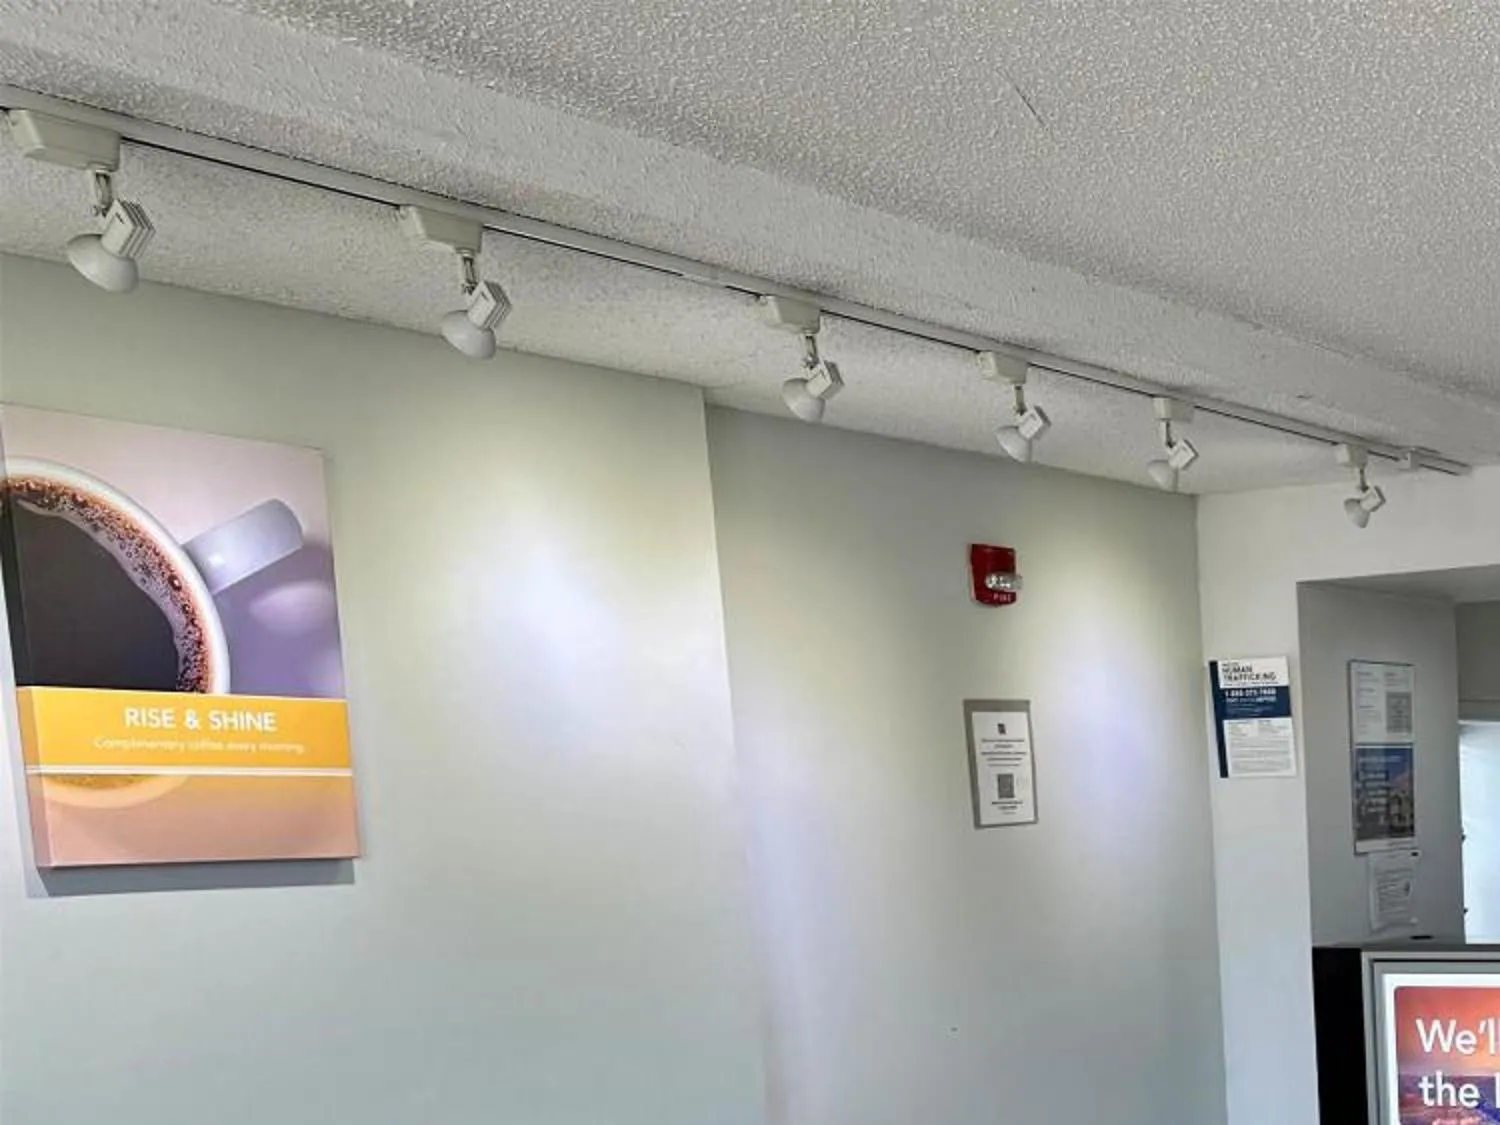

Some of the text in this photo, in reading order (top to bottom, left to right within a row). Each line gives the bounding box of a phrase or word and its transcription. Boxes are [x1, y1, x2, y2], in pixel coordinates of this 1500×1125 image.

[124, 707, 277, 732] RISE & SHINE
[1418, 1070, 1480, 1108] the
